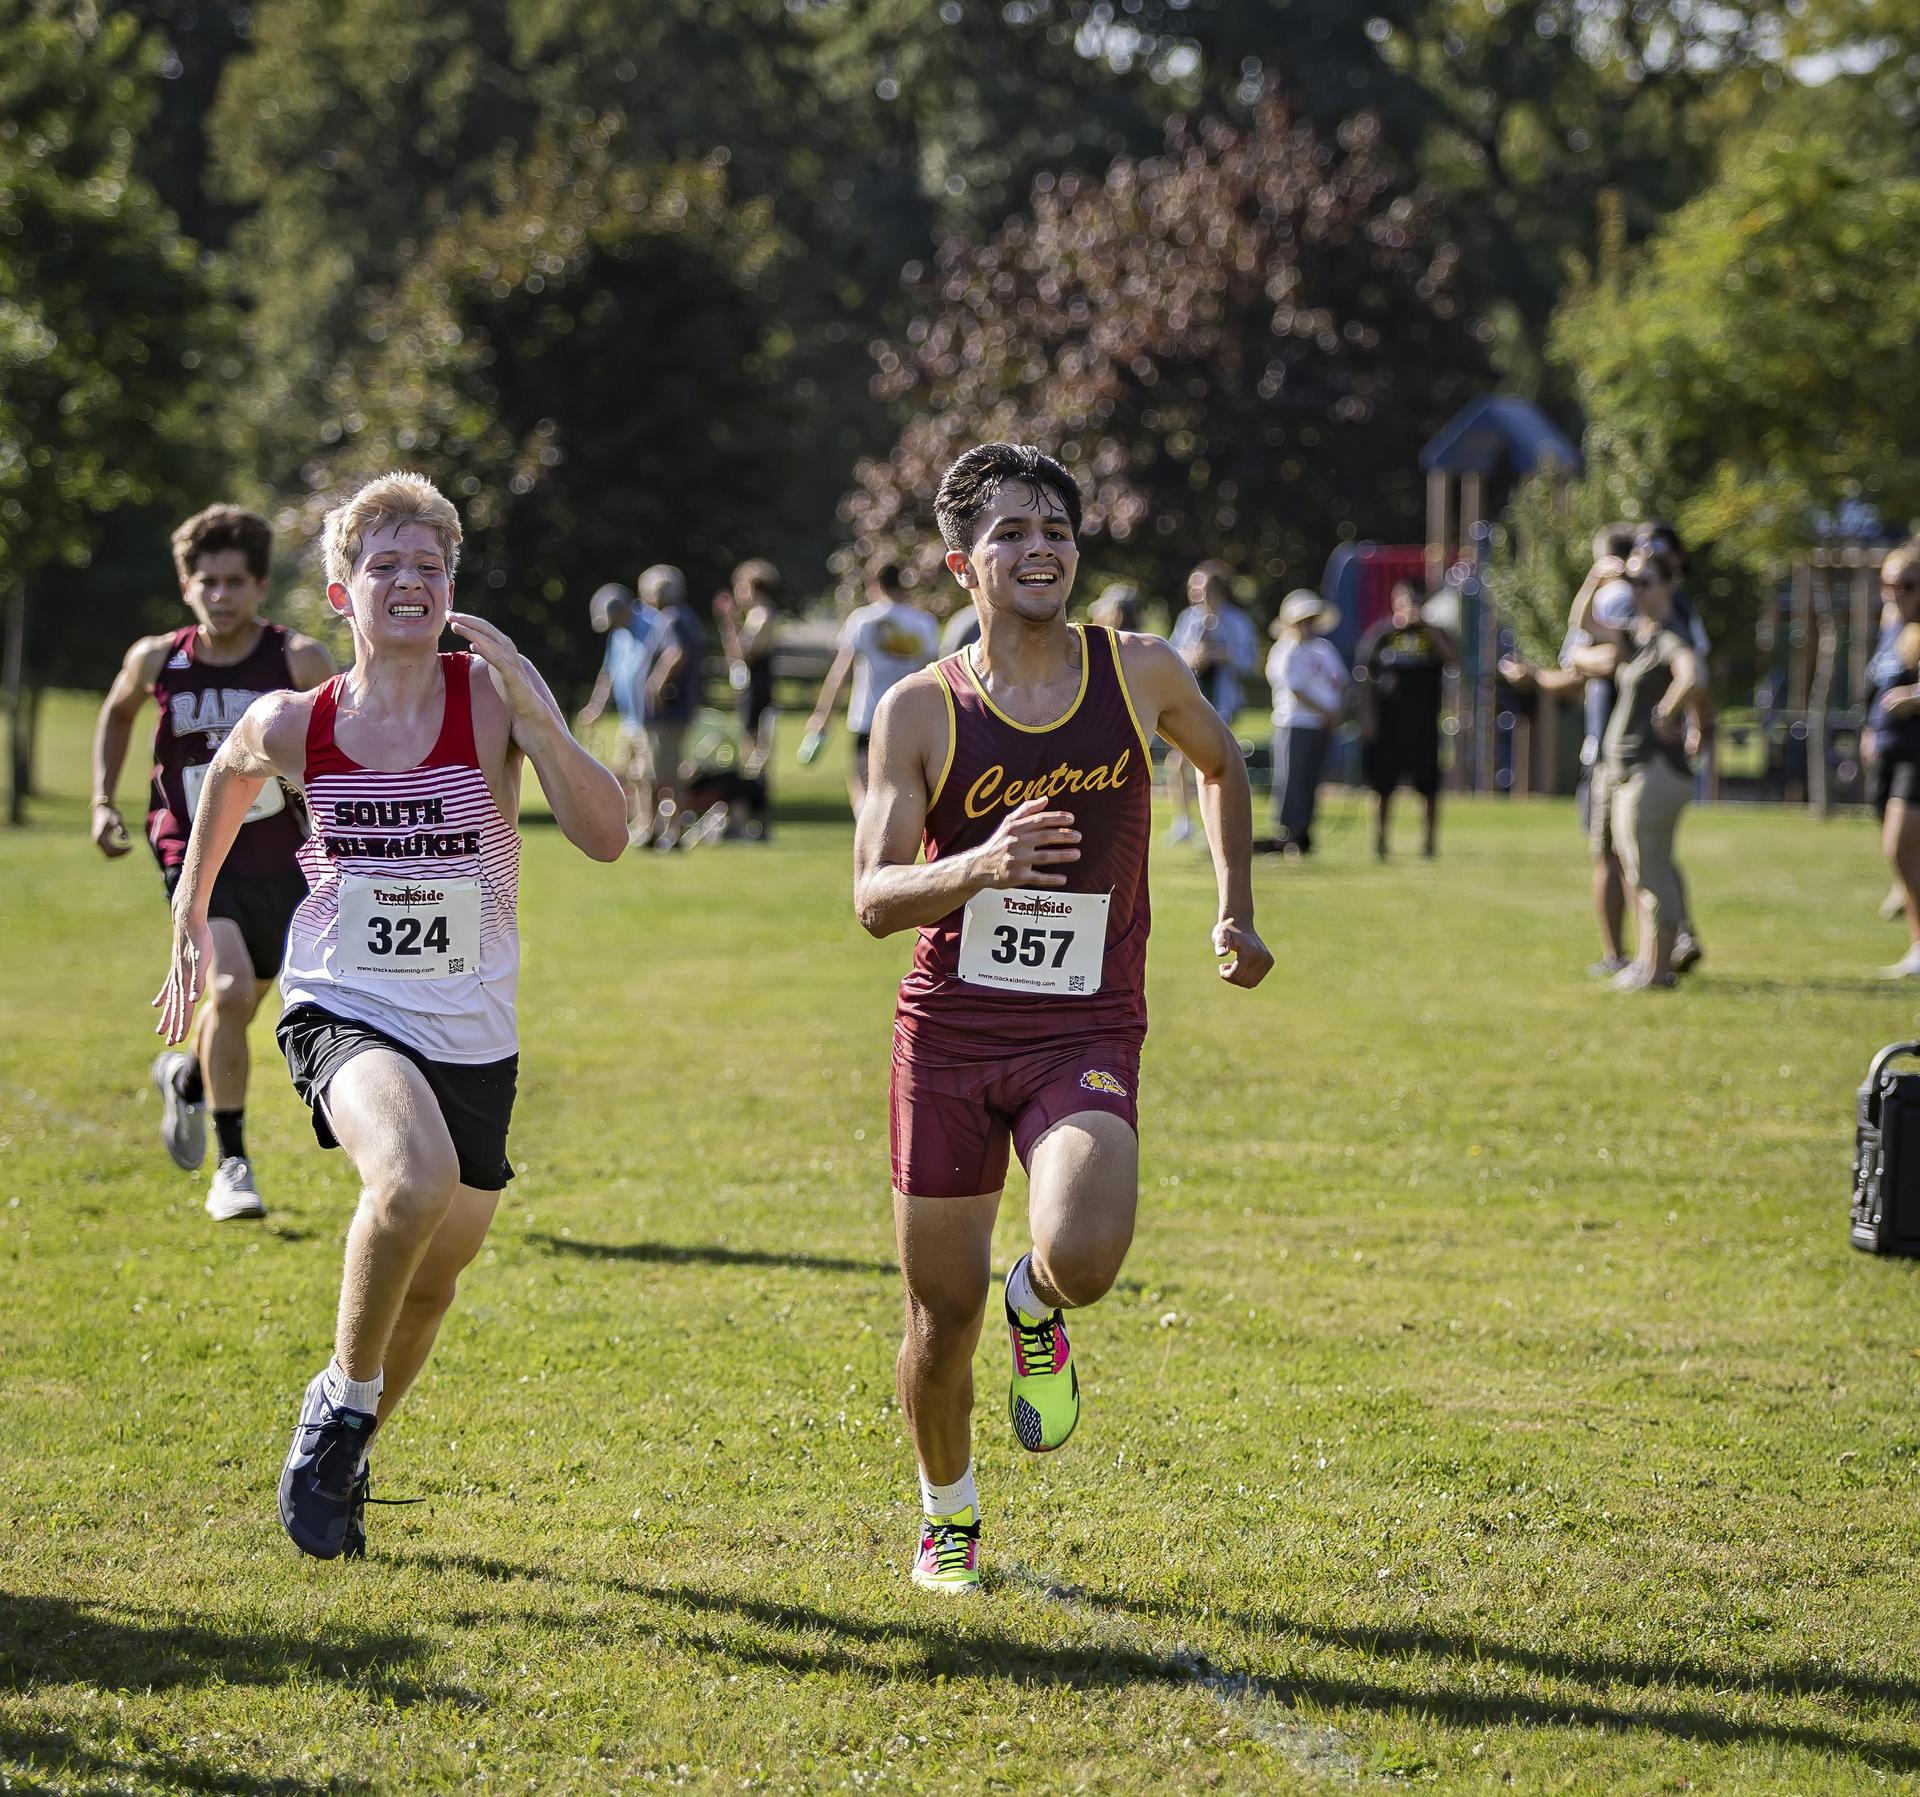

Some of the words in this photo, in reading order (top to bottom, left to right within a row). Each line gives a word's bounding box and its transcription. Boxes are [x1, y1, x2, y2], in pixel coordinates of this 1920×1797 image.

[963, 747, 1131, 819] Central
[334, 796, 446, 827] SOUTH
[367, 916, 451, 956] 324
[991, 925, 1075, 968] 357
